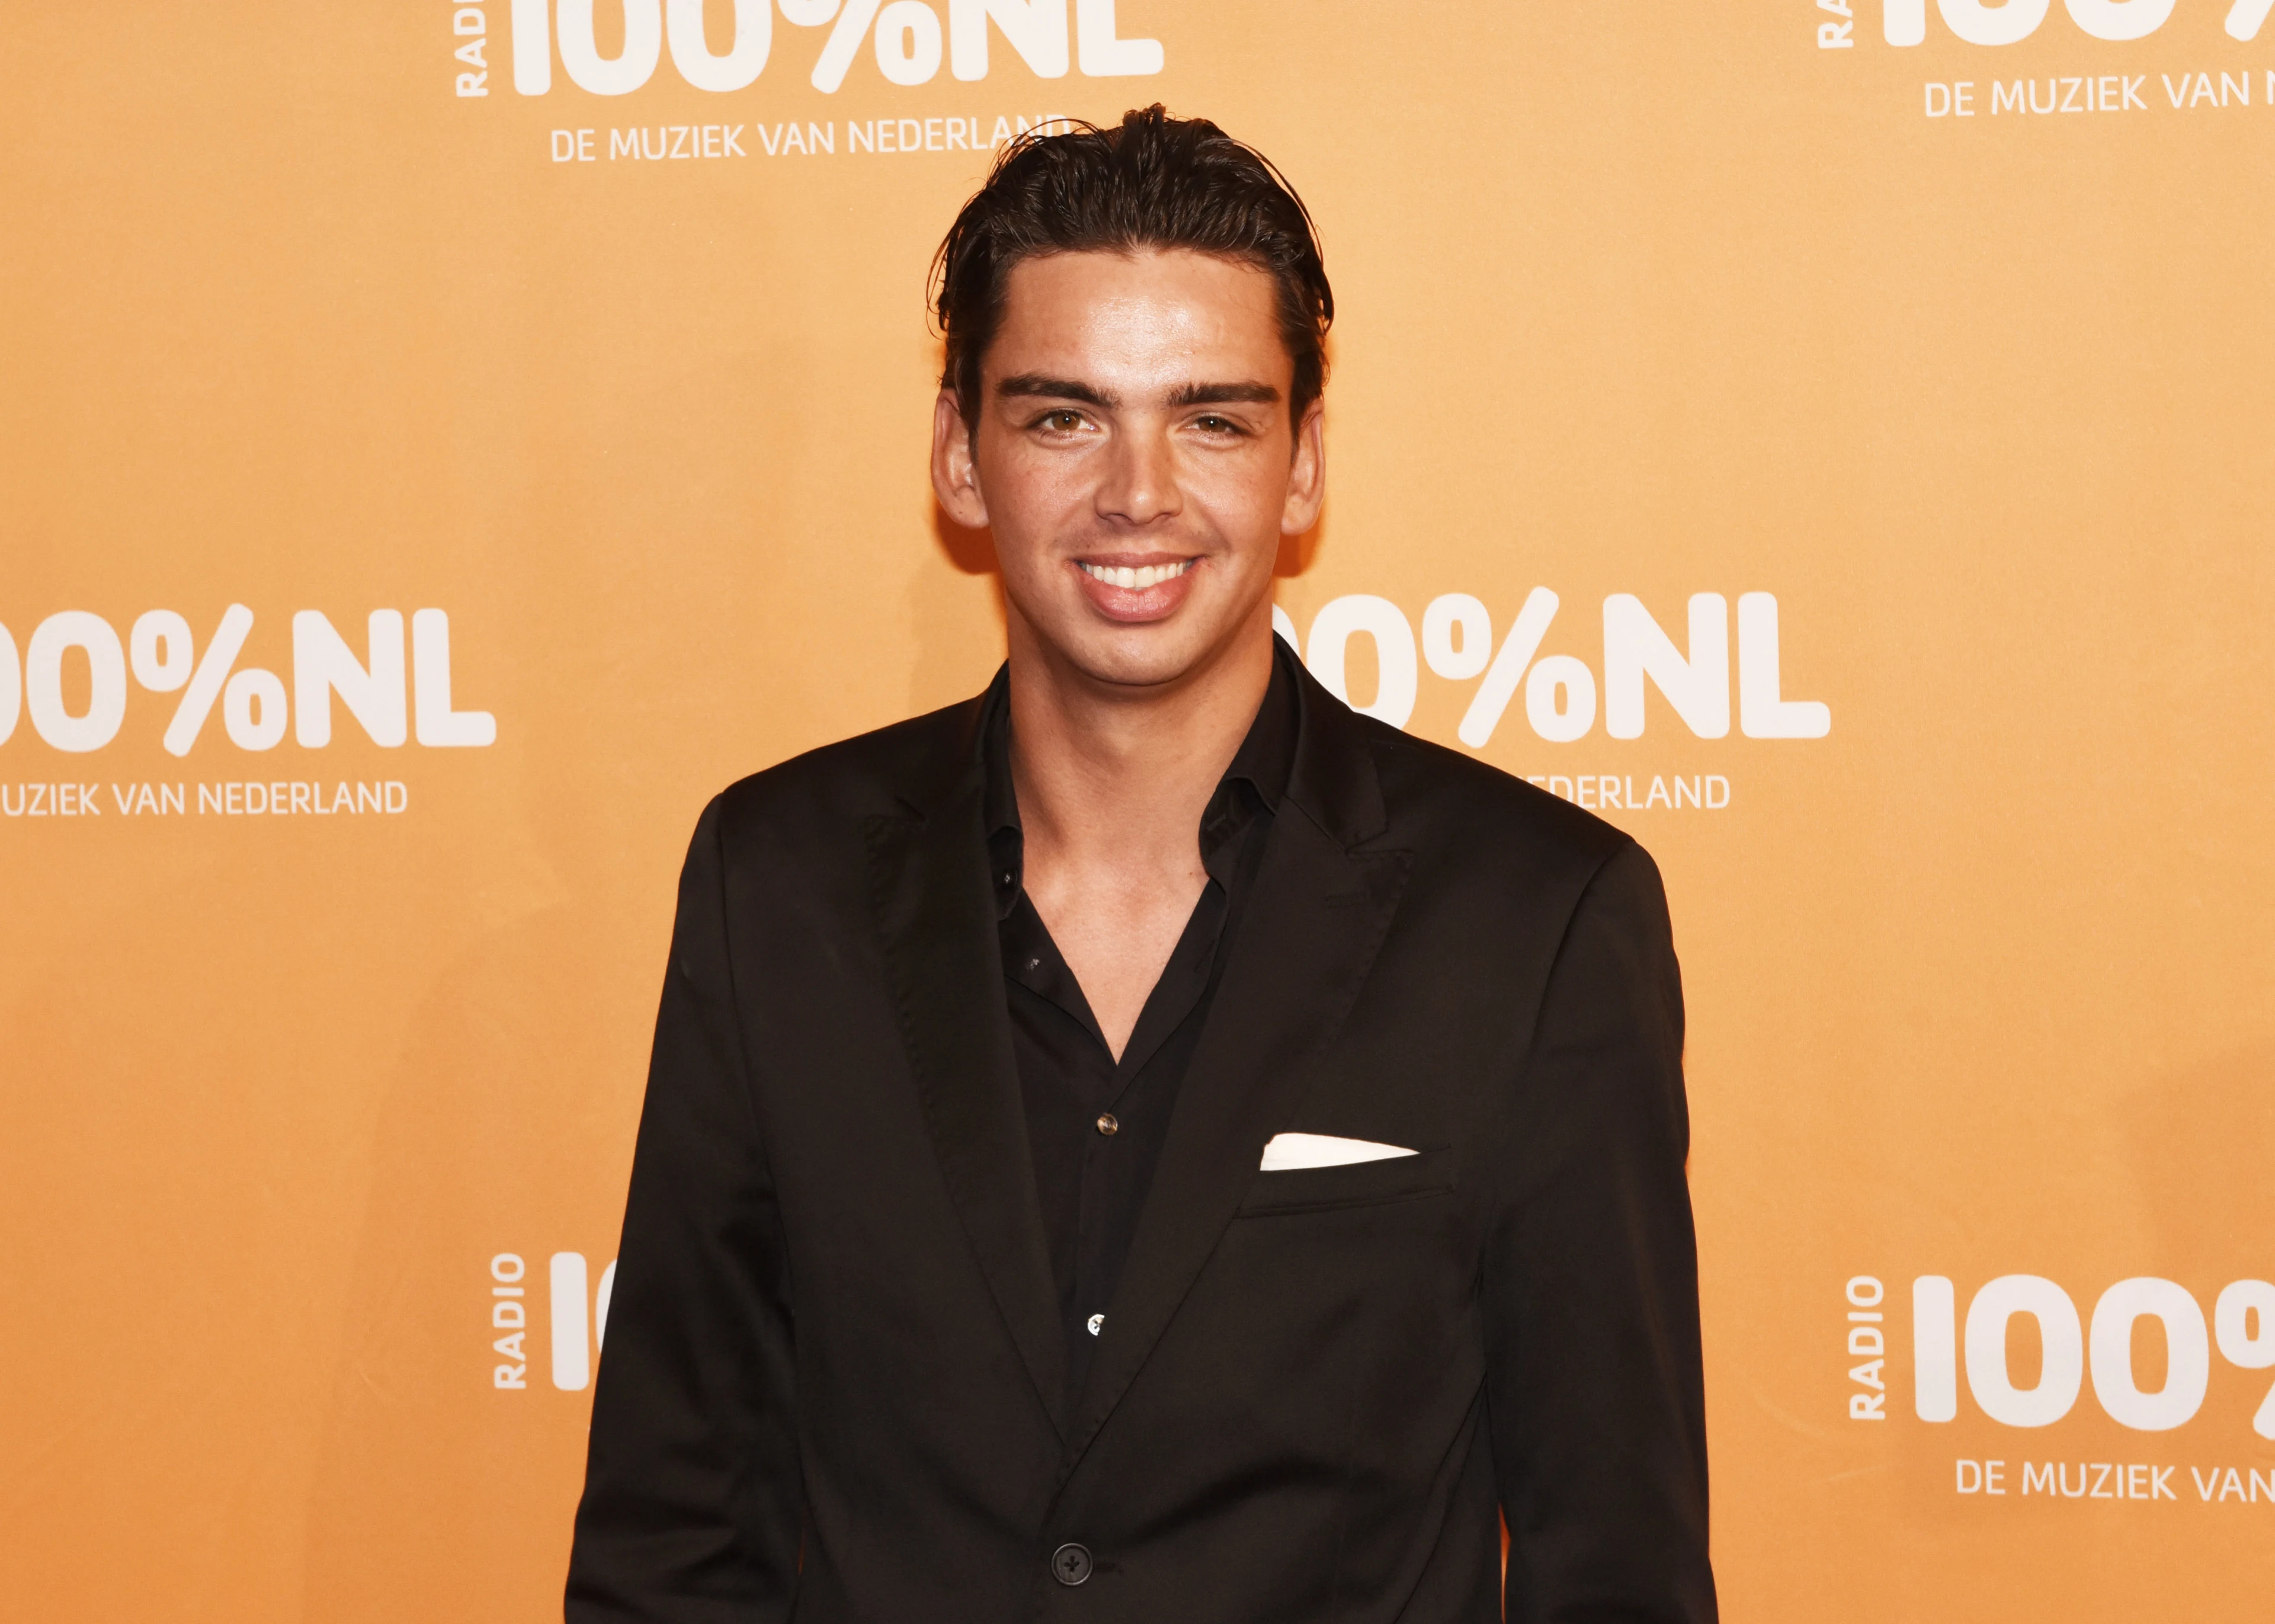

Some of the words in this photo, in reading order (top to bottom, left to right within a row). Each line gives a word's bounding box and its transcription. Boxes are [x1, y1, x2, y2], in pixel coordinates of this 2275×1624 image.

[453, 0, 488, 97] RAD
[511, 0, 1165, 95] 100%NL
[1925, 82, 1975, 117] DE
[1991, 75, 2148, 114] MUZIEK
[2161, 71, 2250, 108] VAN
[551, 129, 595, 162] DE
[610, 124, 746, 161] MUZIEK
[758, 121, 835, 156] VAN
[0, 603, 496, 757] 0%NL
[1273, 585, 1831, 748] 0%NL
[2, 783, 100, 816] UZIEK
[113, 783, 185, 815] VAN
[198, 781, 408, 814] NEDERLAND
[1518, 775, 1732, 809] DERLAND
[491, 1253, 526, 1389] RADIO
[1846, 1276, 1886, 1420] RADIO
[1957, 1460, 2005, 1494] DE
[2022, 1462, 2177, 1500] MUZIEK
[2191, 1466, 2275, 1503] VAN
